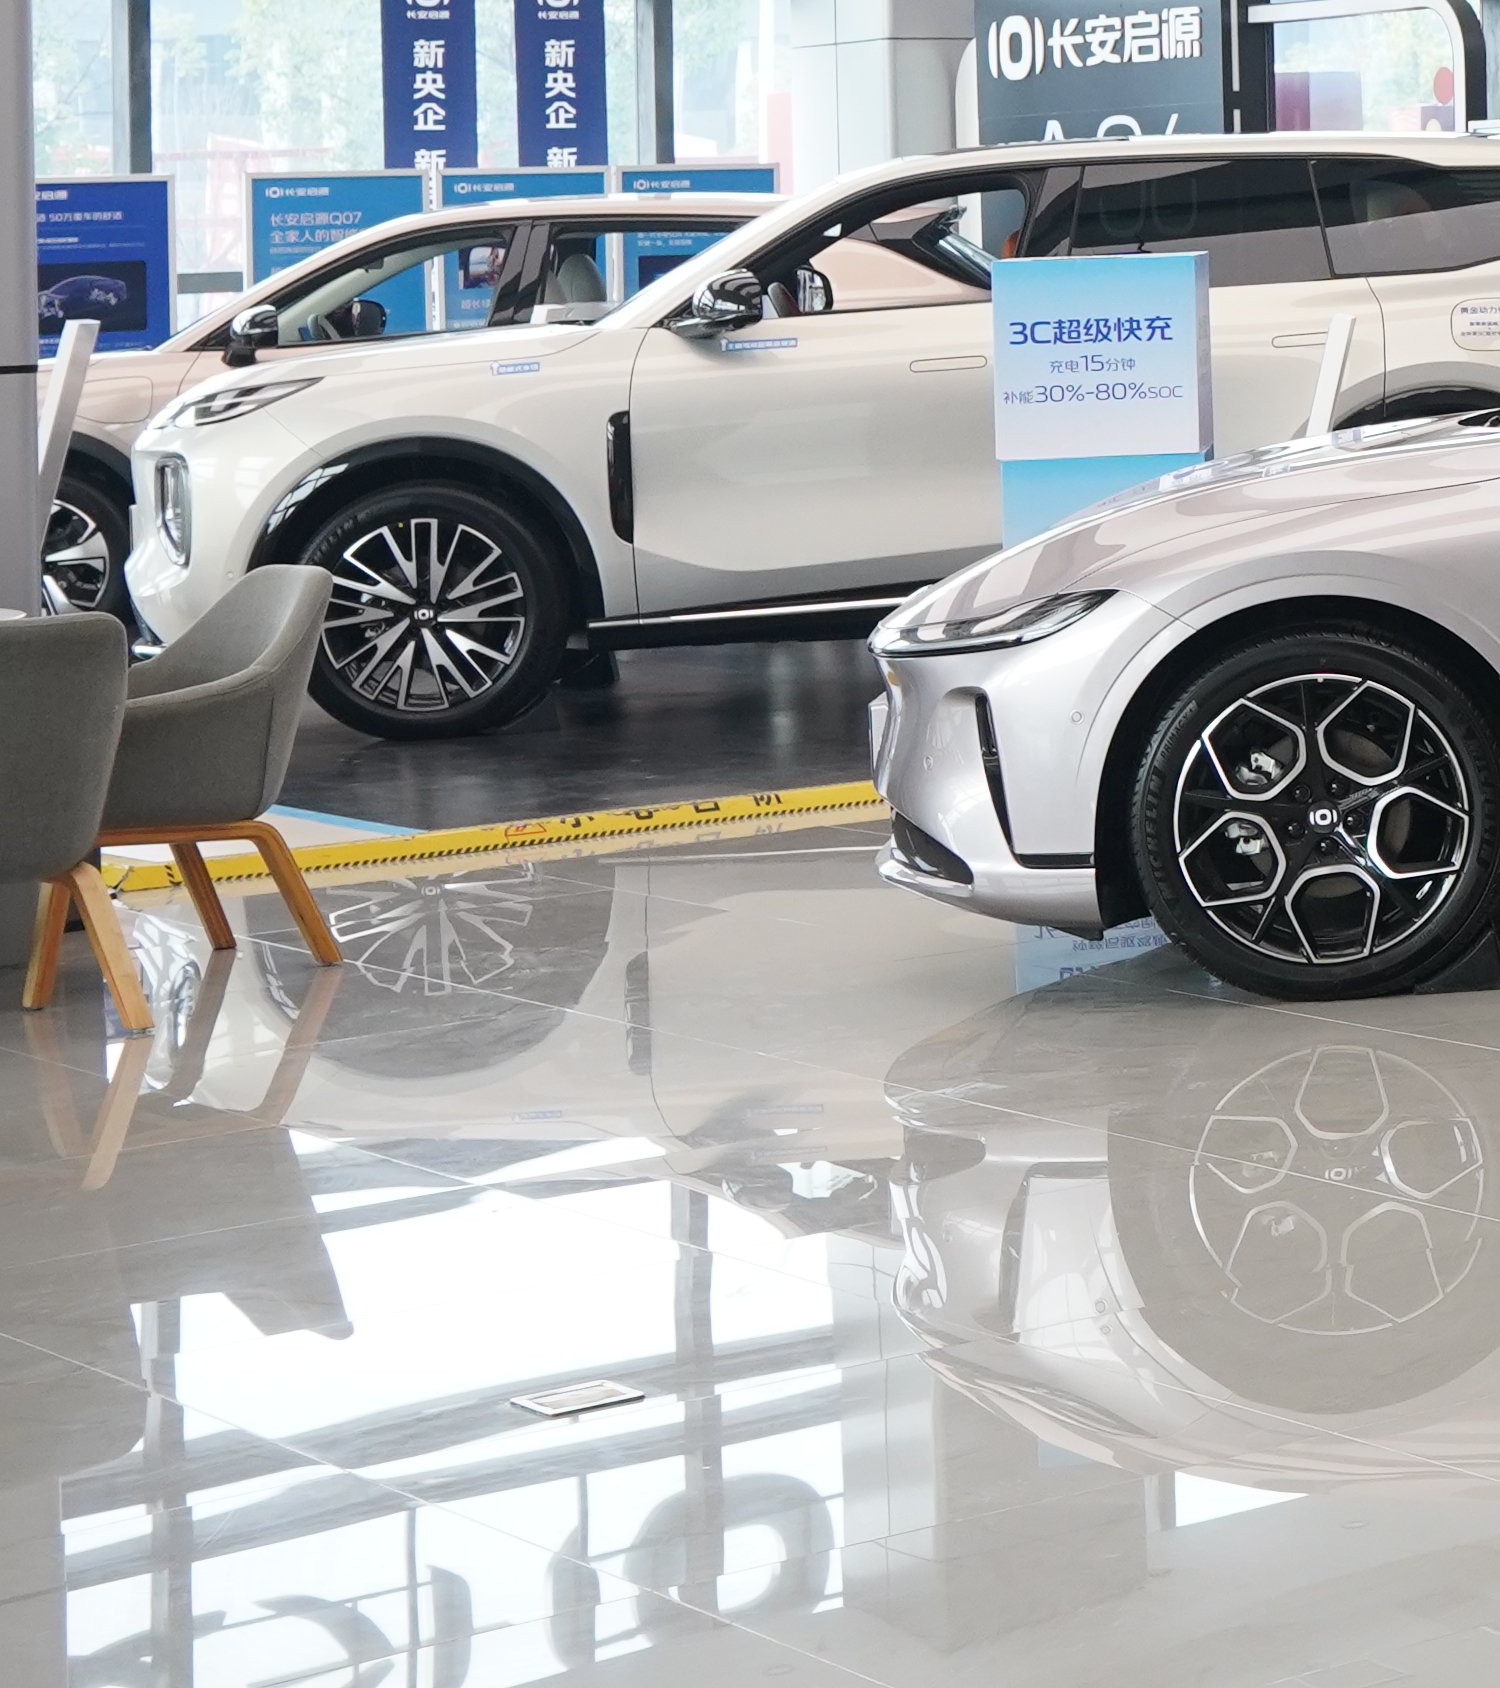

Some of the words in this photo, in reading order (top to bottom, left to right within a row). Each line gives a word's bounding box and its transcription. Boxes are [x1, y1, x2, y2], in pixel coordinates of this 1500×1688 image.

[1047, 5, 1203, 69] 长安启源
[412, 38, 446, 131] 新央企
[544, 38, 577, 129] 新央企
[270, 211, 363, 227] 长安启源Q07
[270, 228, 366, 244] 全家人的智能
[1008, 315, 1173, 345] 3C超级快充
[1049, 353, 1136, 374] 充电15分钟
[1003, 382, 1184, 405] 补能30%-80%SOC
